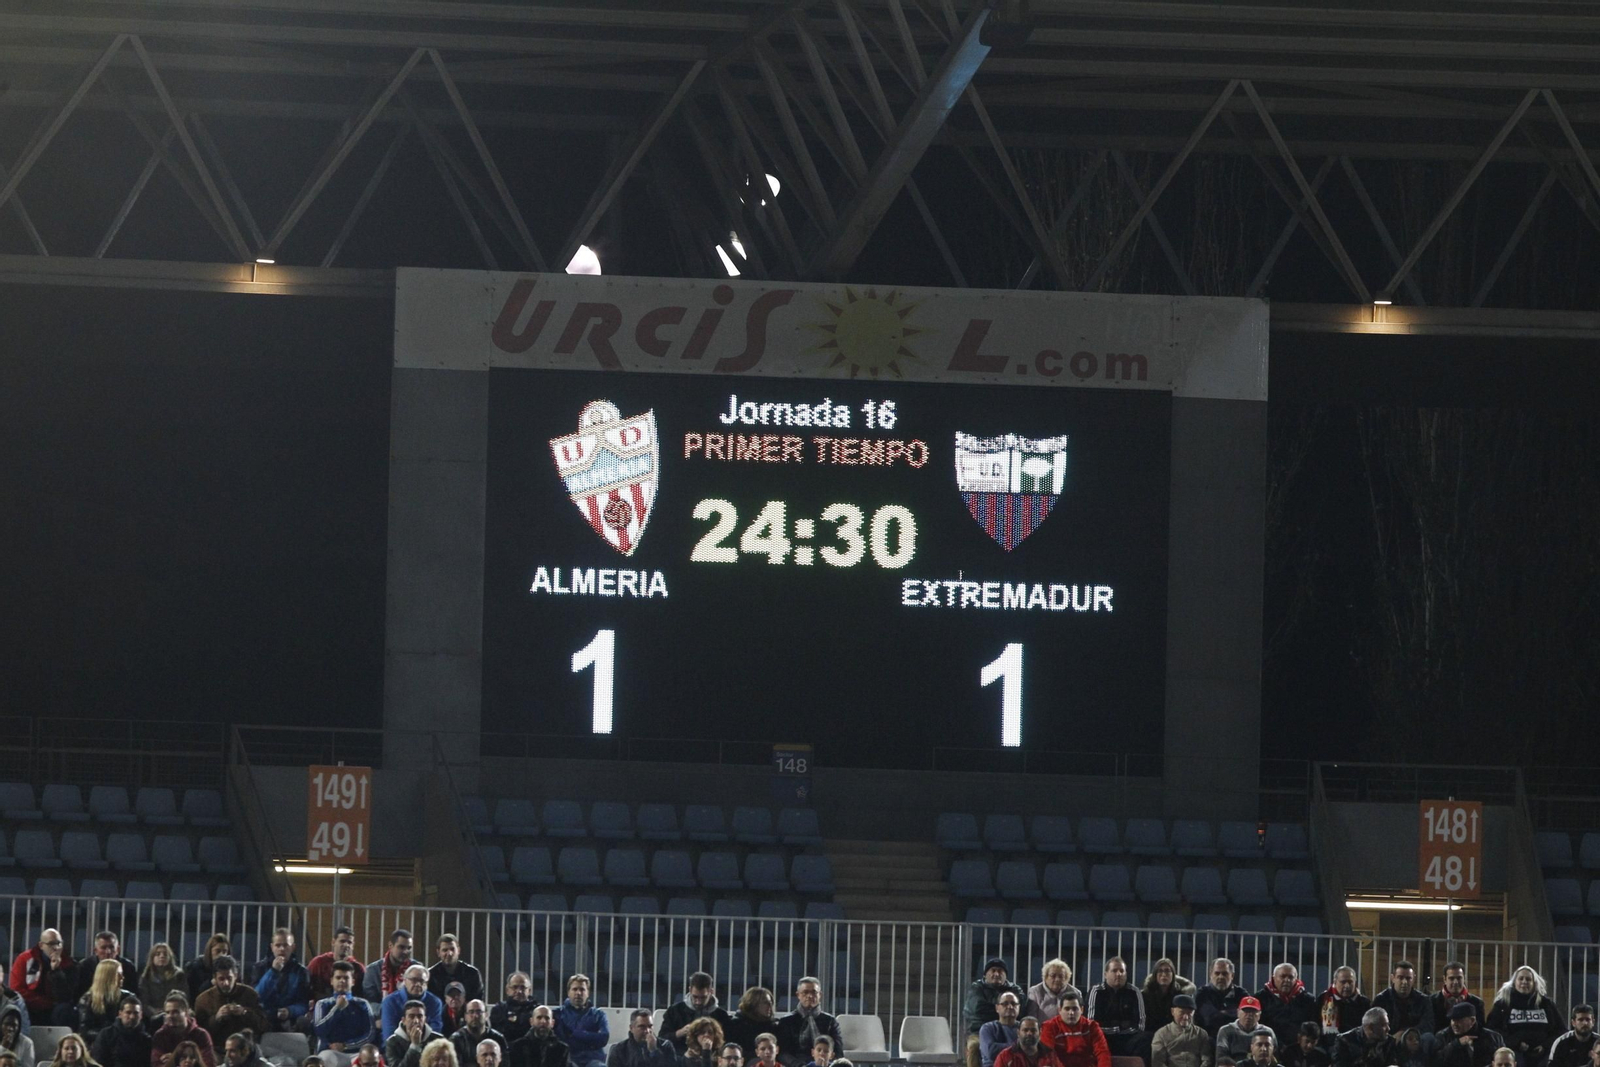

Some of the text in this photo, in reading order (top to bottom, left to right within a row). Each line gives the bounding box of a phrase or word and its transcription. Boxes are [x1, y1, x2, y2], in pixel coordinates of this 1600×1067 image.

[719, 394, 898, 430] Jornada 16
[684, 431, 804, 463] PRIMER
[812, 436, 930, 469] TIEMPO
[690, 499, 918, 569] 24:30
[530, 565, 669, 598] ALMERIA
[901, 578, 1114, 612] EXTREMADUR
[571, 629, 615, 735] 1
[980, 642, 1024, 748] 1
[775, 757, 808, 774] 148
[312, 772, 357, 810] 149
[311, 821, 351, 858] 49
[1424, 806, 1467, 844] 148
[1424, 855, 1463, 891] 48
[1509, 1012, 1546, 1021] adidas
